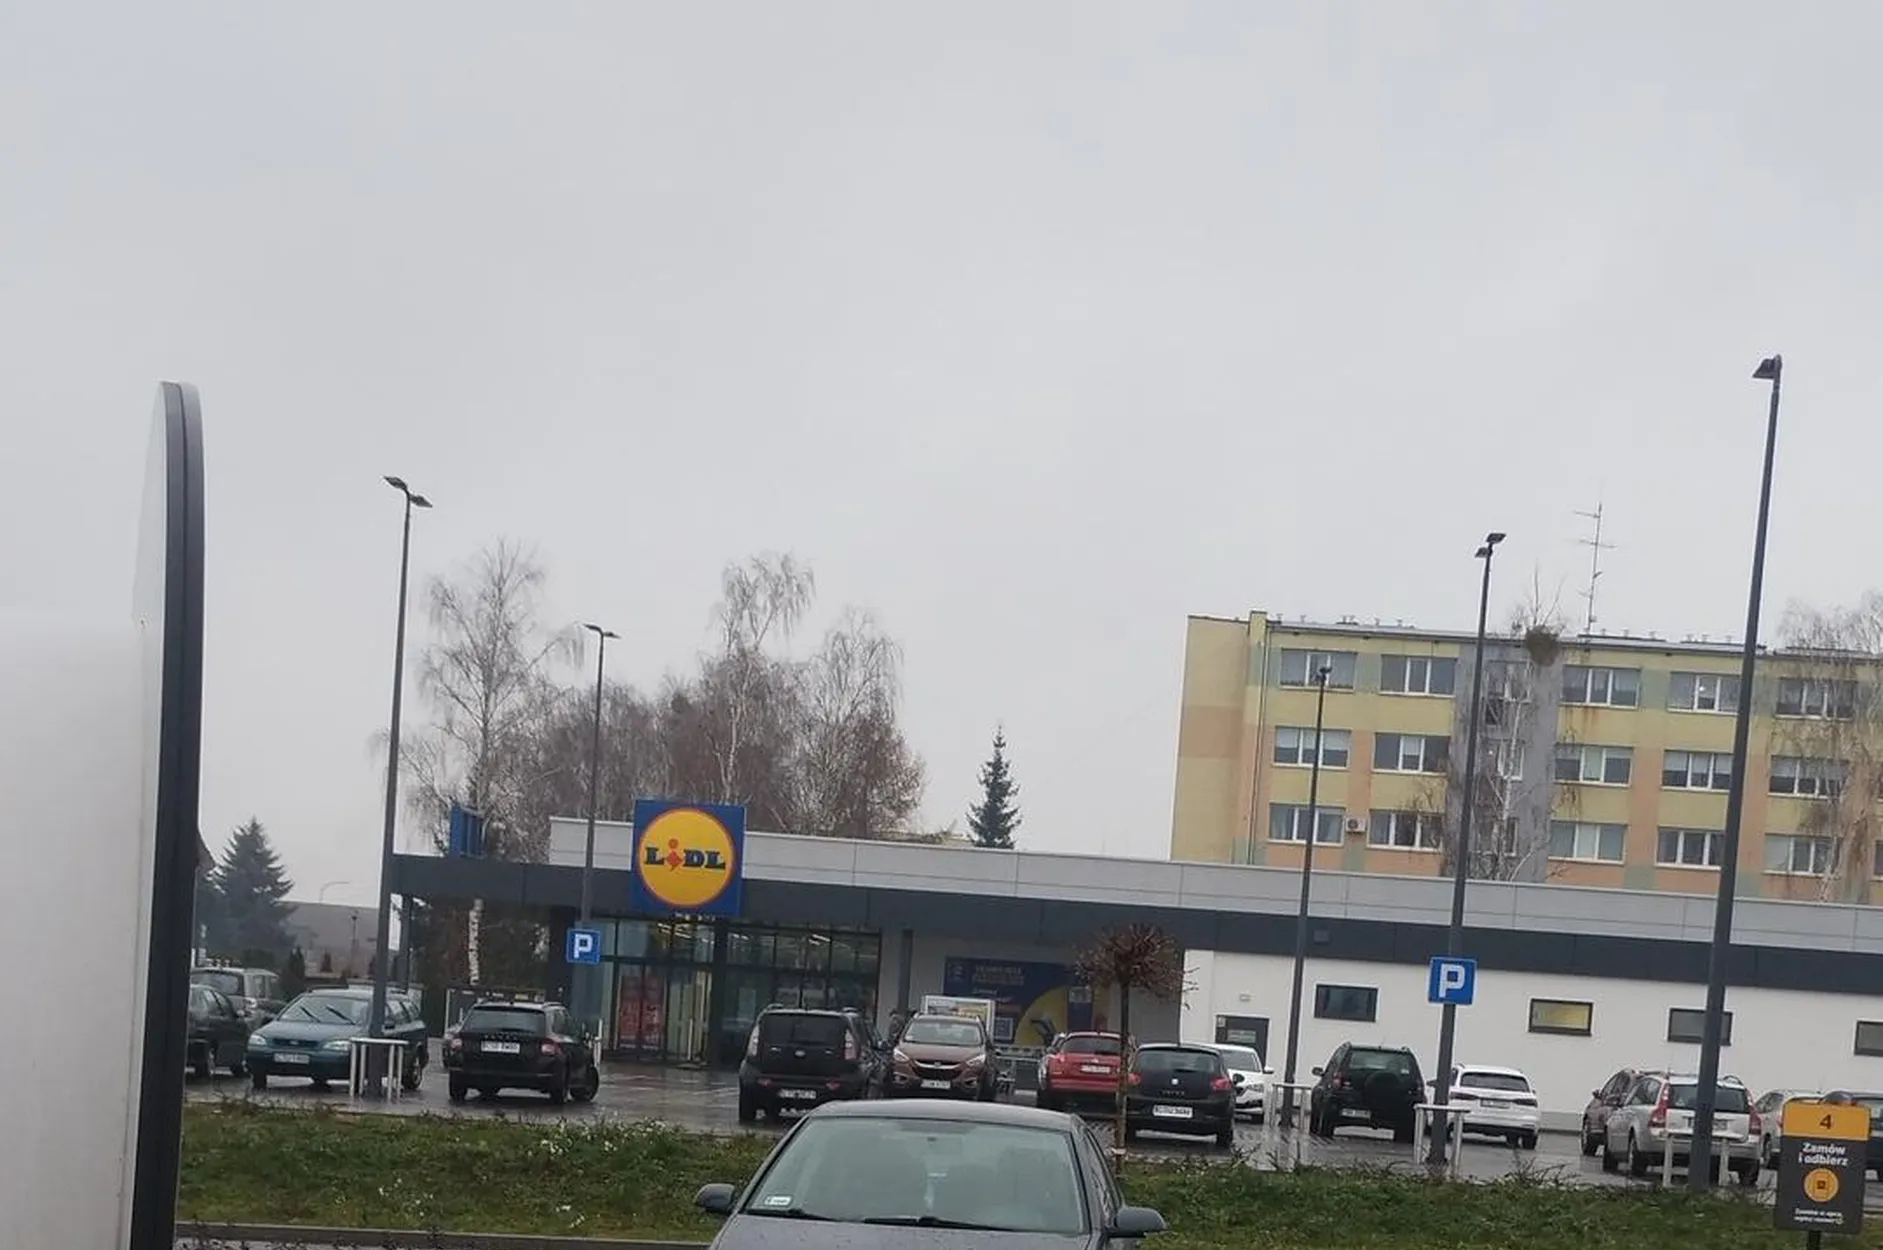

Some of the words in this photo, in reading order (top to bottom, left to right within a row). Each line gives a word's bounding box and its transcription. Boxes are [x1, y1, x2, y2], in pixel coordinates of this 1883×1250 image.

[573, 933, 593, 959] P
[1438, 963, 1466, 998] P
[1820, 1113, 1832, 1130] 4
[1802, 1142, 1846, 1155] Zamów
[1804, 1153, 1849, 1166] odbierz
